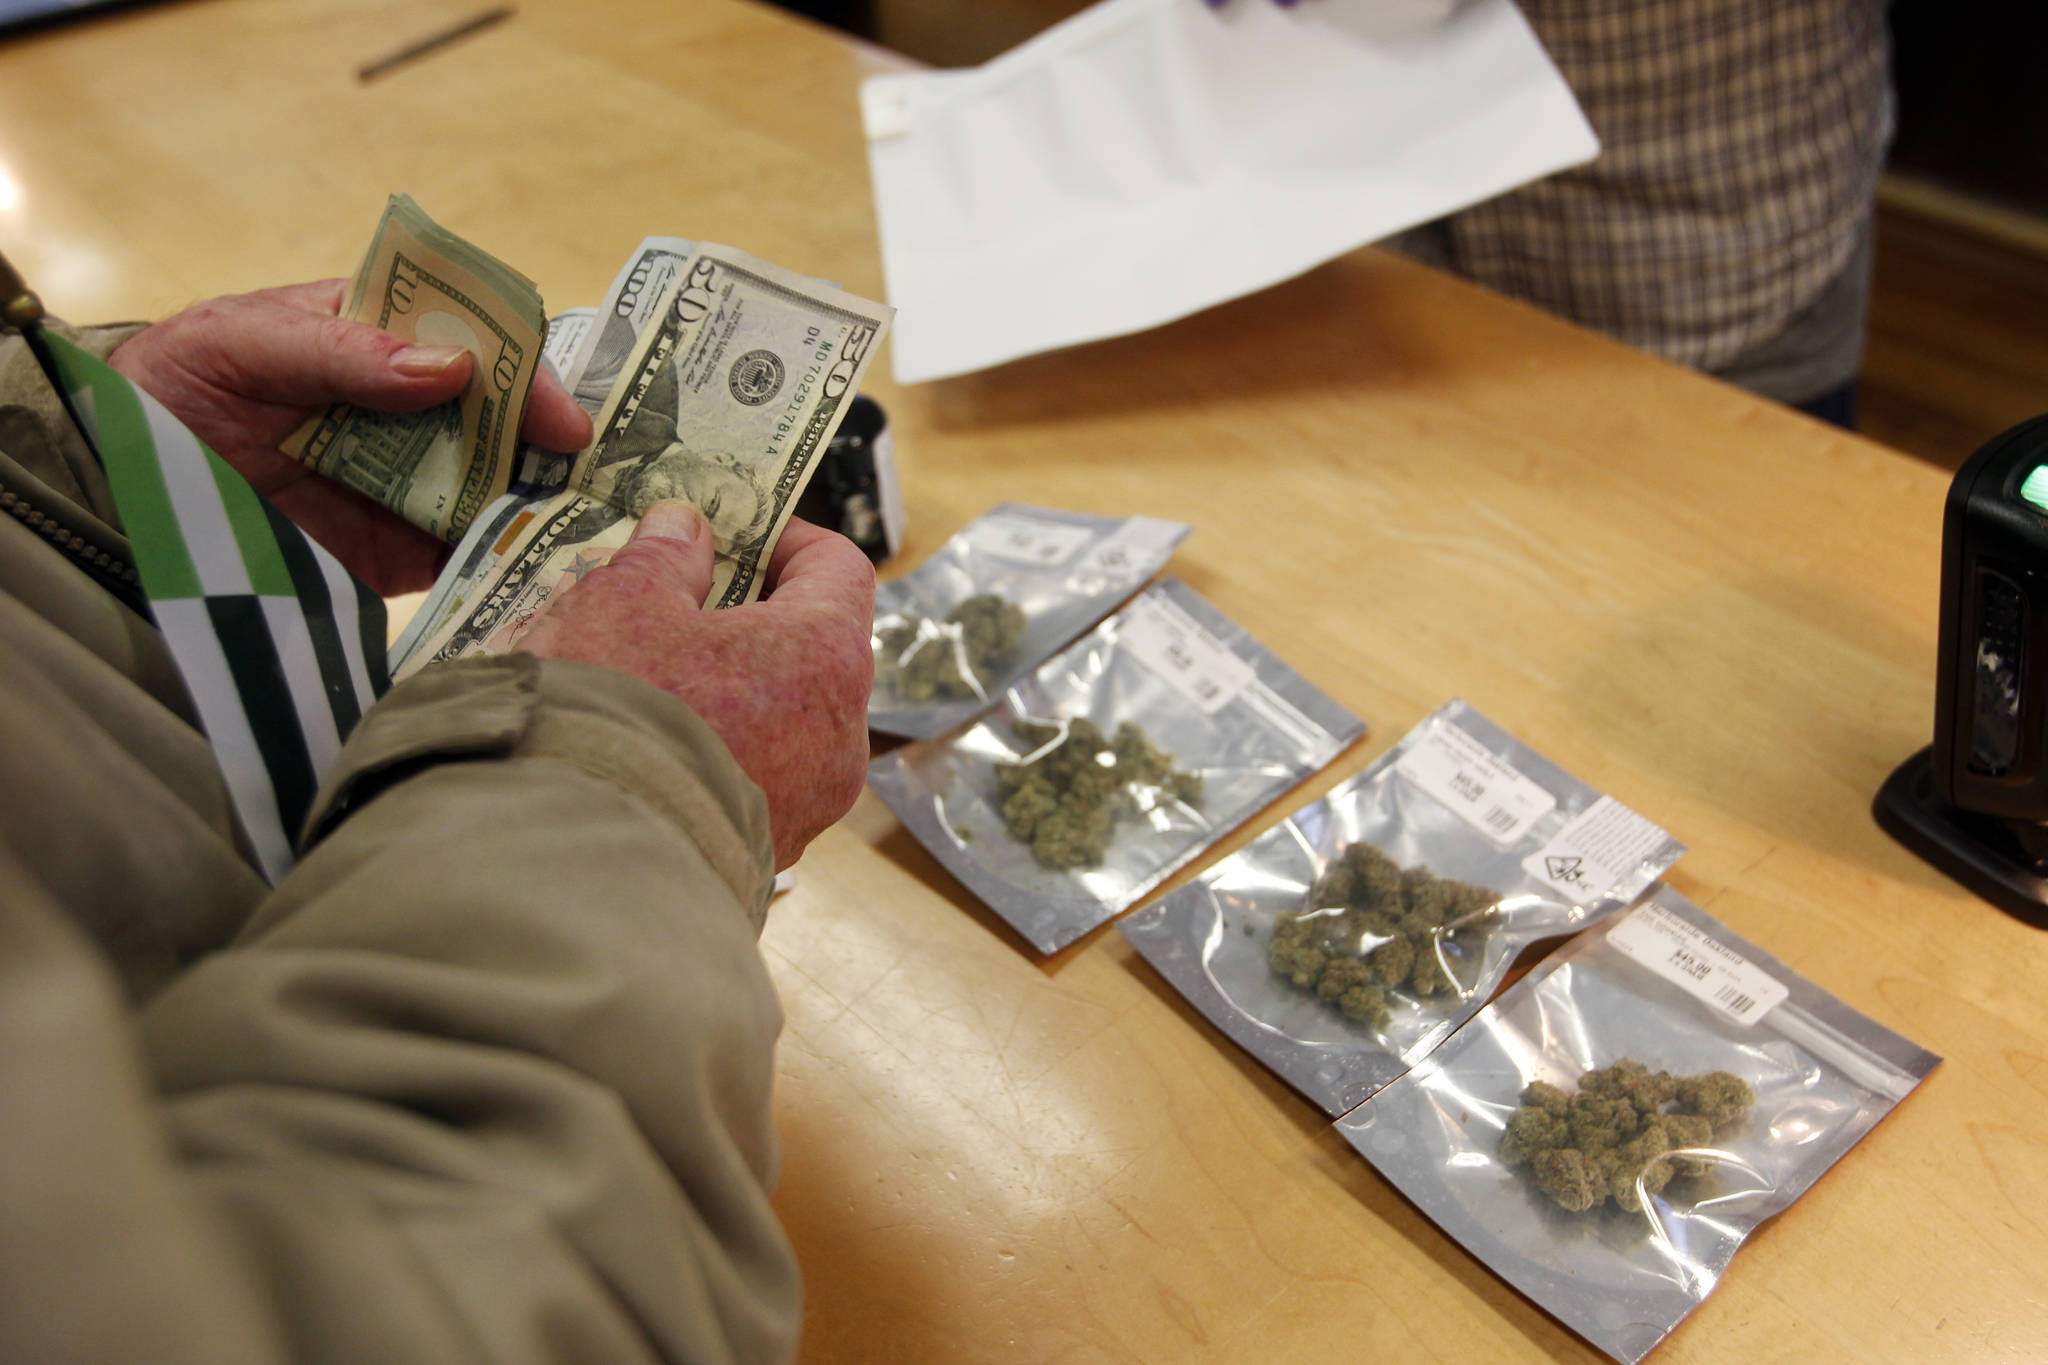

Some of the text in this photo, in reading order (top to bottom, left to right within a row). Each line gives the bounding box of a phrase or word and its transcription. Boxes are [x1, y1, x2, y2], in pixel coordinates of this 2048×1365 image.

[389, 254, 420, 315] 10
[616, 255, 654, 319] 100
[676, 257, 717, 323] 50
[494, 337, 524, 393] 10
[802, 327, 820, 347] D4
[823, 326, 874, 398] 50
[765, 340, 833, 455] MD 70291784 A
[782, 411, 826, 488] FEDERAL
[435, 494, 448, 512] IN
[473, 497, 591, 629] DOLLARS
[1702, 936, 1744, 966] Oakland
